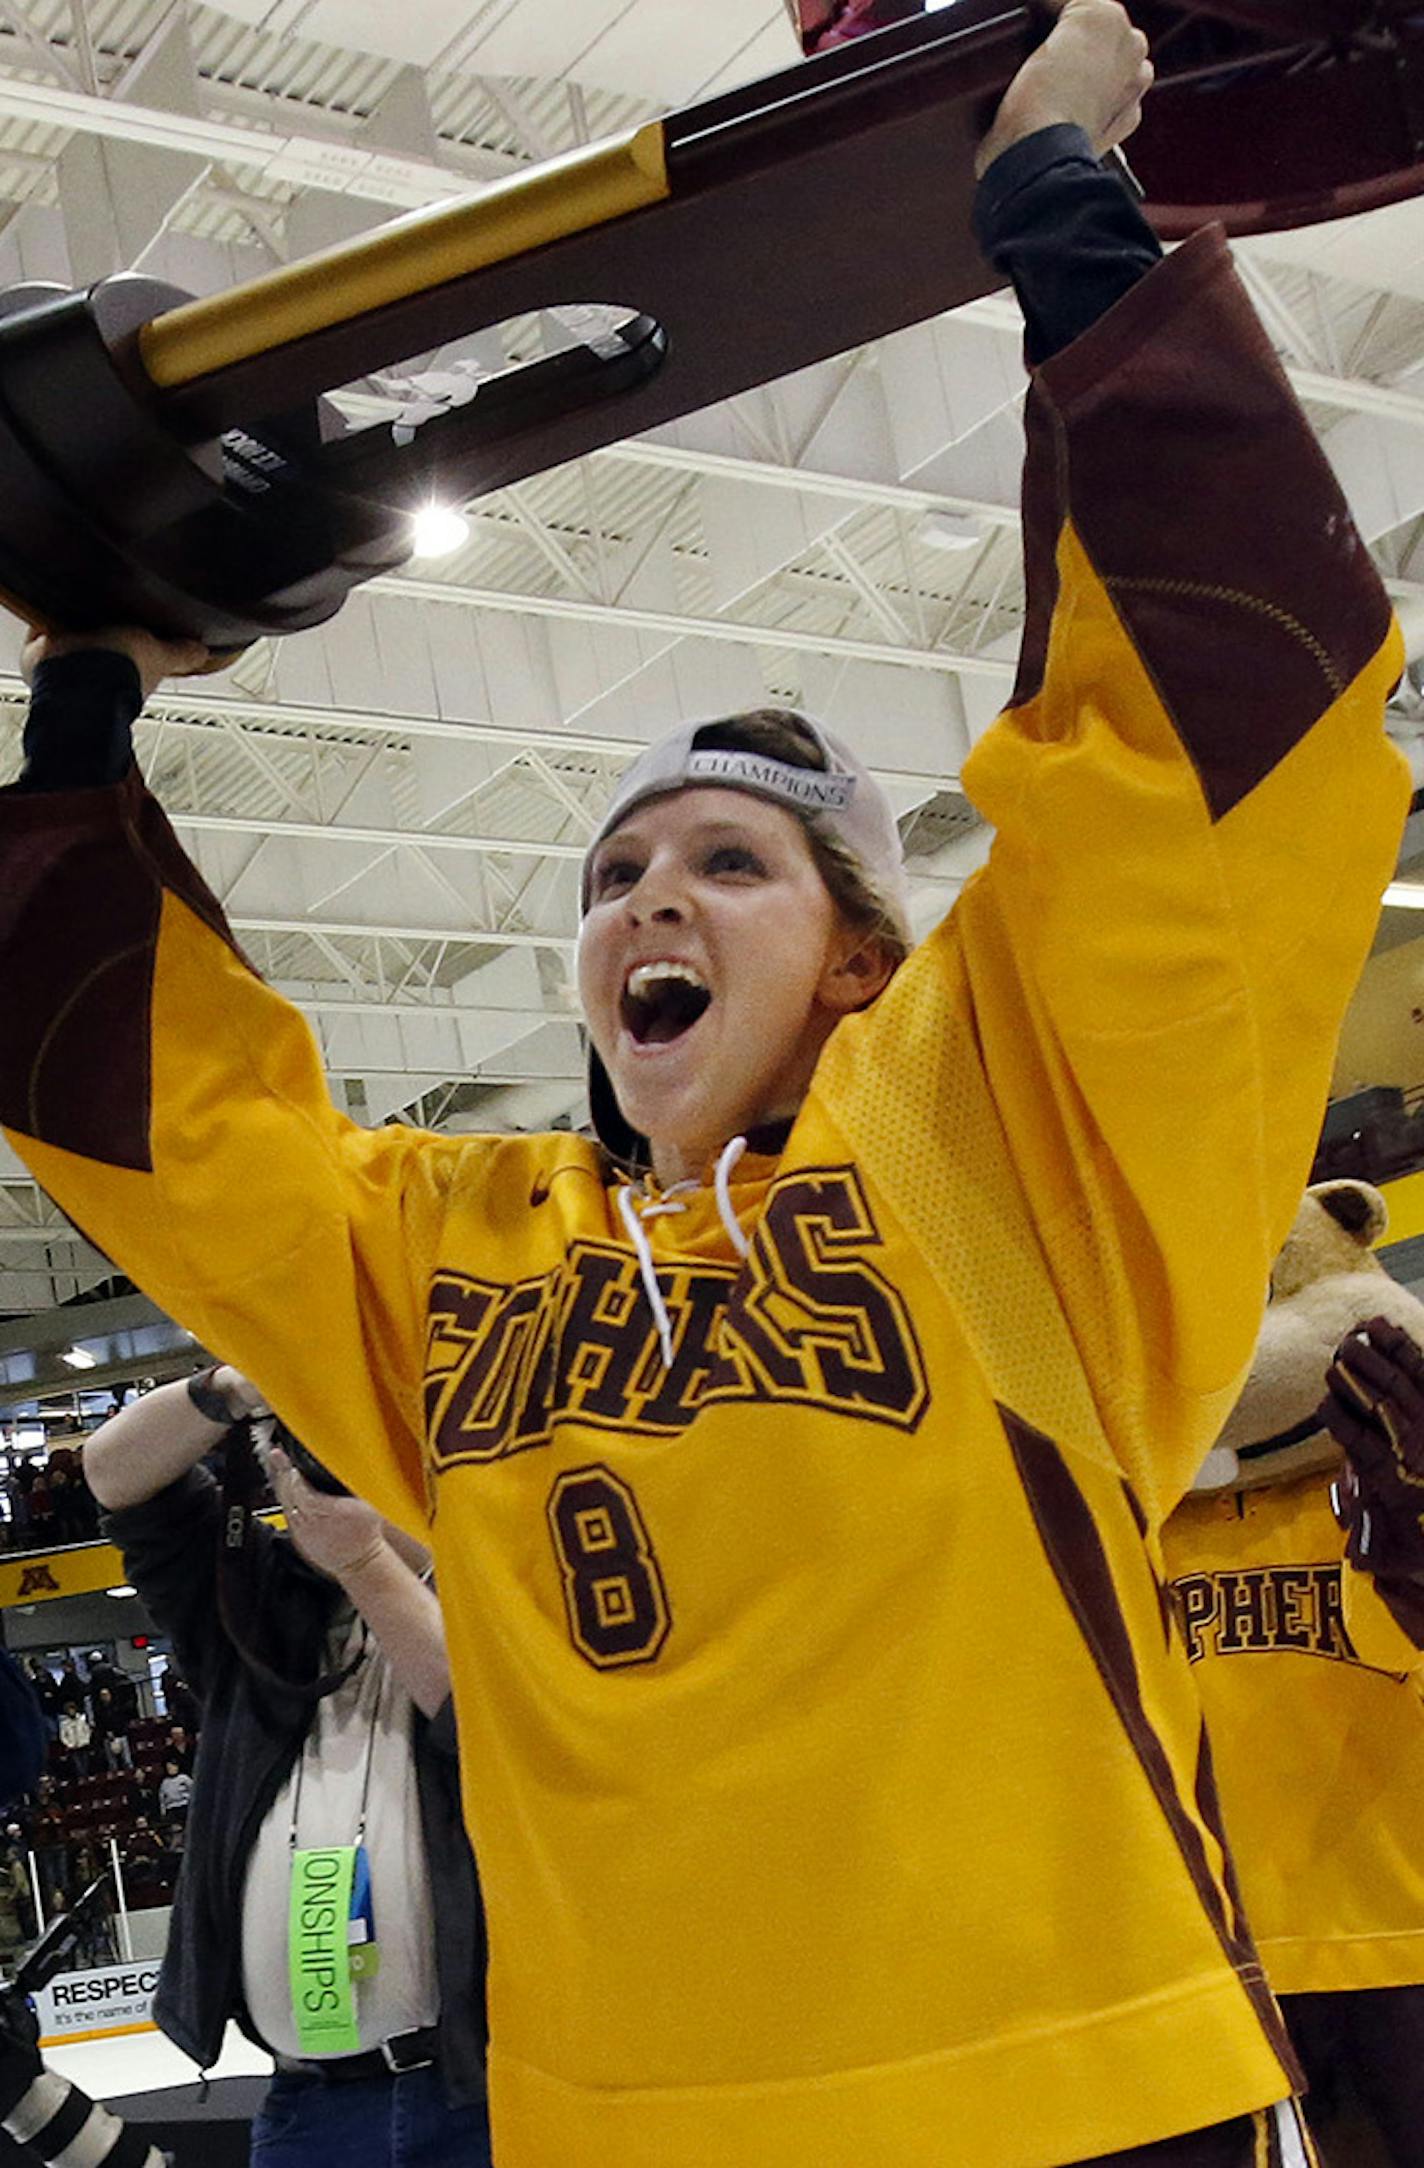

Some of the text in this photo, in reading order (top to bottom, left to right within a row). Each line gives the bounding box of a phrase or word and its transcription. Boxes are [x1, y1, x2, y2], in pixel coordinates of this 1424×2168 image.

[693, 758, 845, 806] CHAMPIONS
[545, 1463, 672, 1671] 8
[301, 1850, 342, 2013] IONSHIPS
[52, 1970, 161, 2006] RESPEC
[55, 2000, 148, 2026] It's the name of
